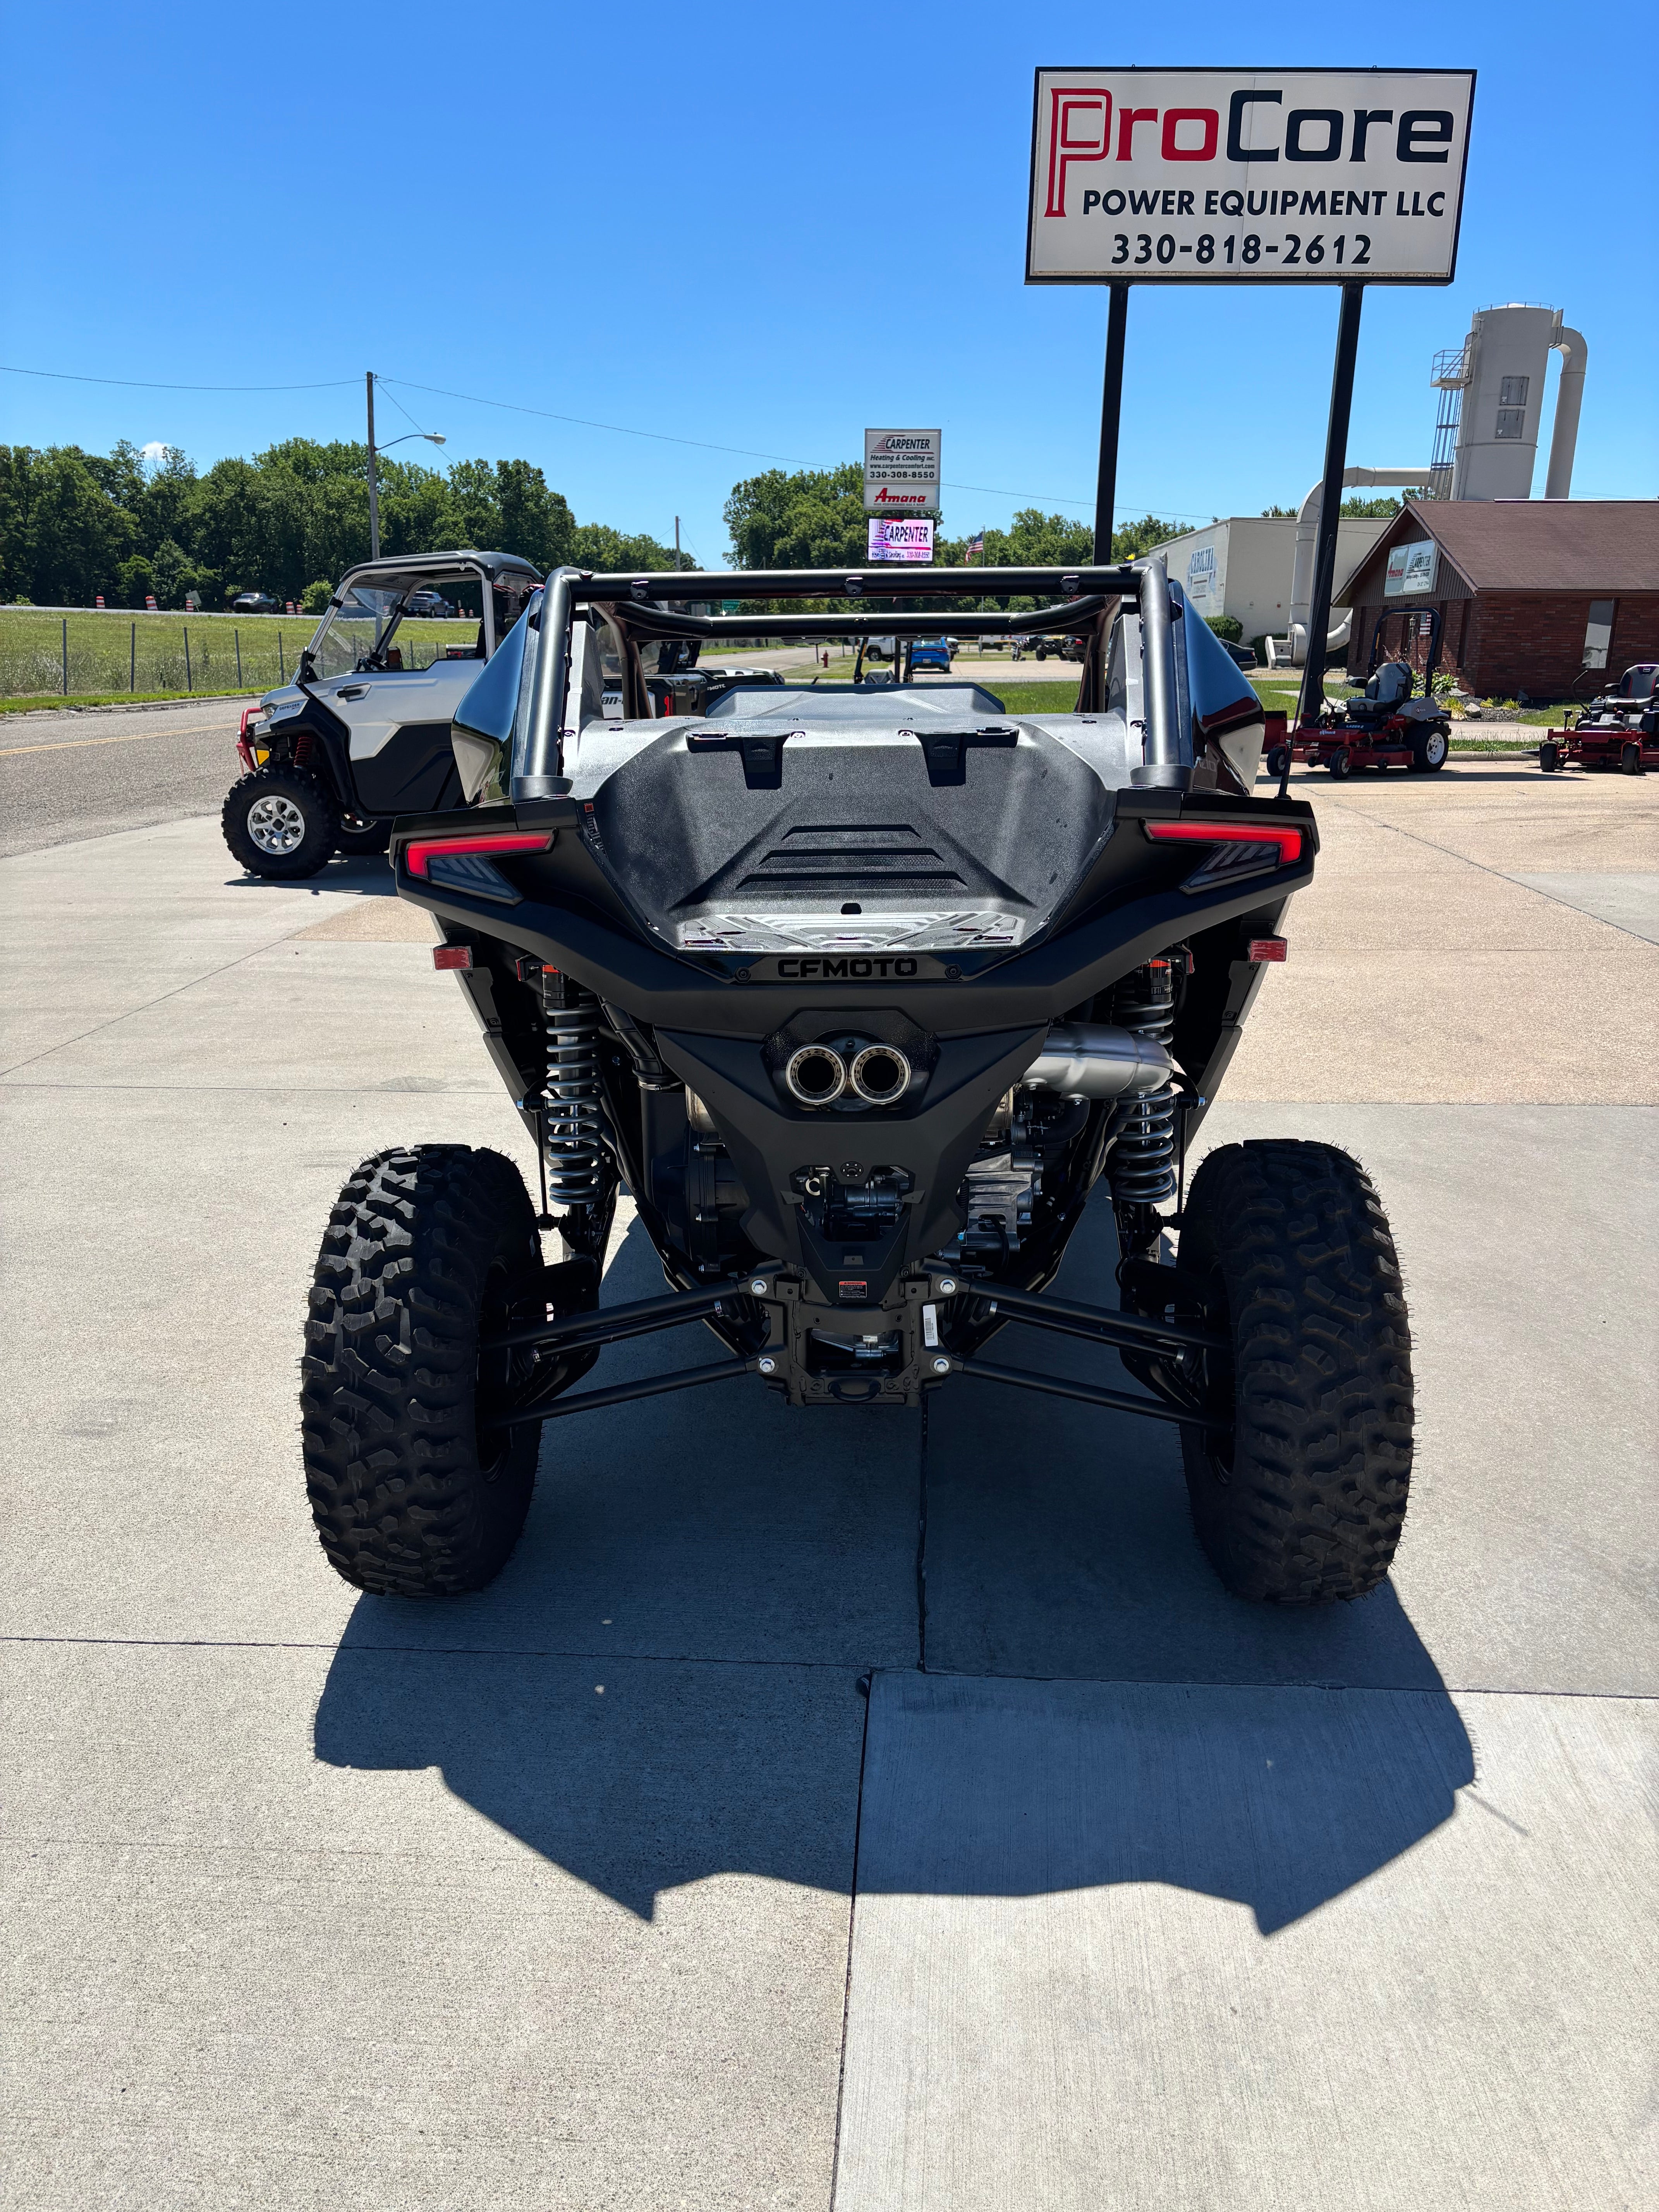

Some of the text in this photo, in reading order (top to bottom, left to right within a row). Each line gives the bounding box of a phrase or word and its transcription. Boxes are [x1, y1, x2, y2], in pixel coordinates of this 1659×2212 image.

[1044, 88, 1454, 217] ProCore
[1084, 189, 1445, 217] POWER EQUIPMENT LLC
[1111, 234, 1371, 264] 330-818-2612
[886, 439, 930, 449] CARPENTER
[874, 488, 926, 503] Amana
[884, 526, 928, 542] CARPENTER
[778, 958, 917, 977] CFMOTO
